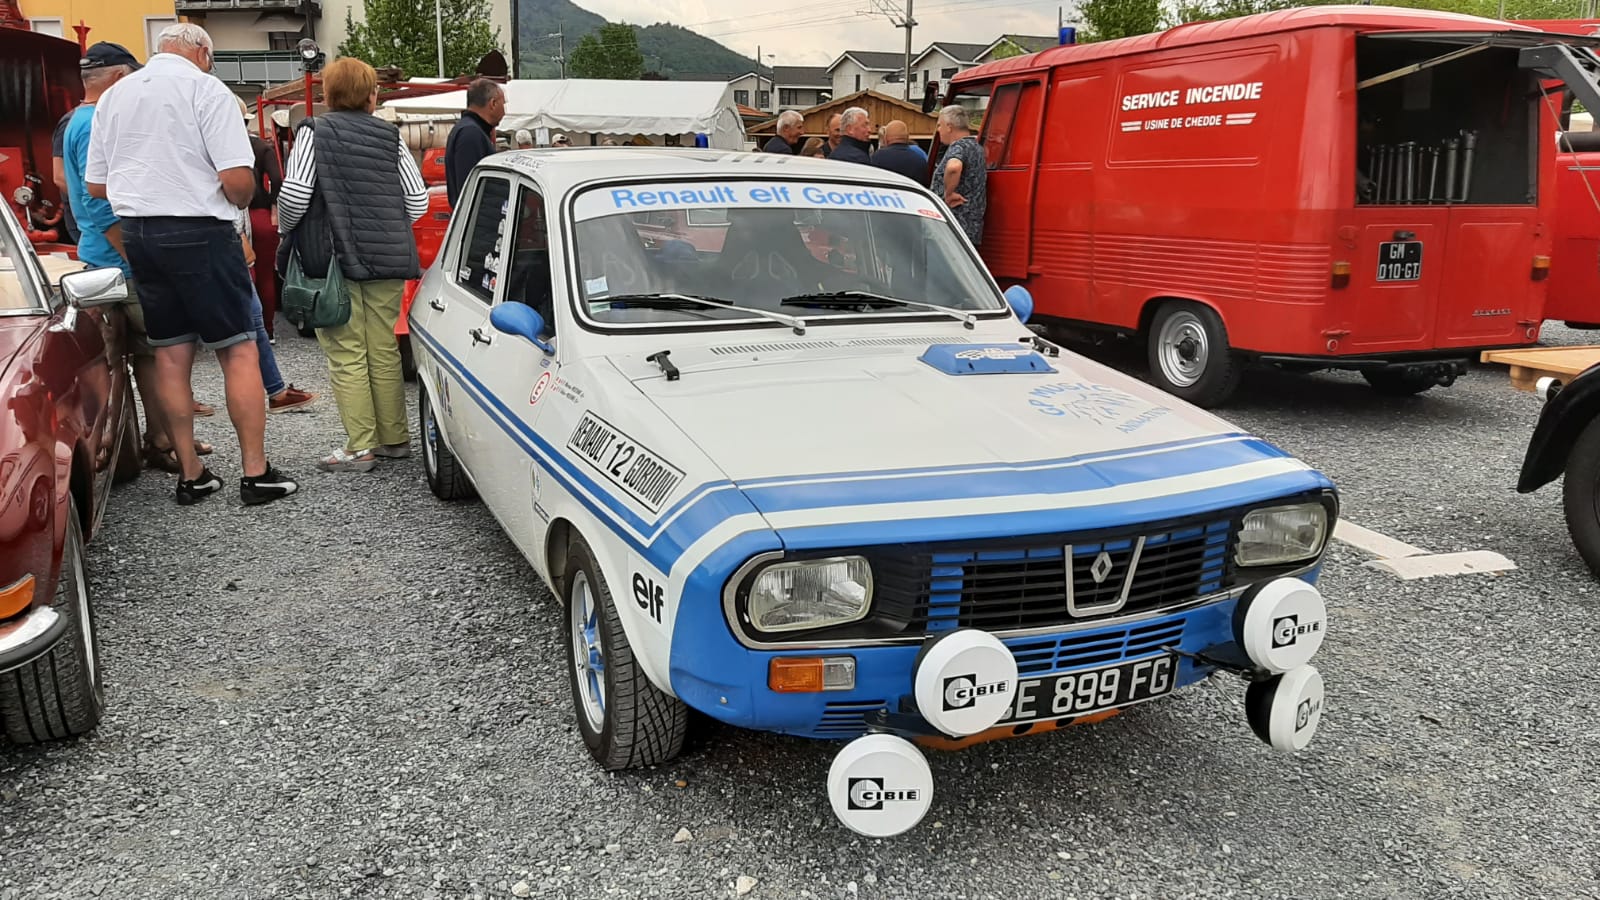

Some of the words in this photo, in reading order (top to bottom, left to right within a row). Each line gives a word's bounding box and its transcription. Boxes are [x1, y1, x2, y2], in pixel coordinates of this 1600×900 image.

[1121, 90, 1180, 111] SERVICE
[1185, 82, 1263, 104] INCENDIE
[1144, 118, 1169, 130] USINE
[1170, 117, 1183, 128] DE
[1184, 114, 1222, 127] CHEDDE
[611, 186, 738, 208] Renault
[749, 185, 791, 204] elf
[802, 187, 906, 210] Gordini
[571, 416, 617, 463] RENAULT
[606, 440, 636, 477] 12
[622, 453, 679, 506] GORDINI
[632, 571, 664, 625] elf
[1000, 679, 1041, 720] E
[1052, 668, 1121, 714] 899
[1128, 657, 1171, 700] FG
